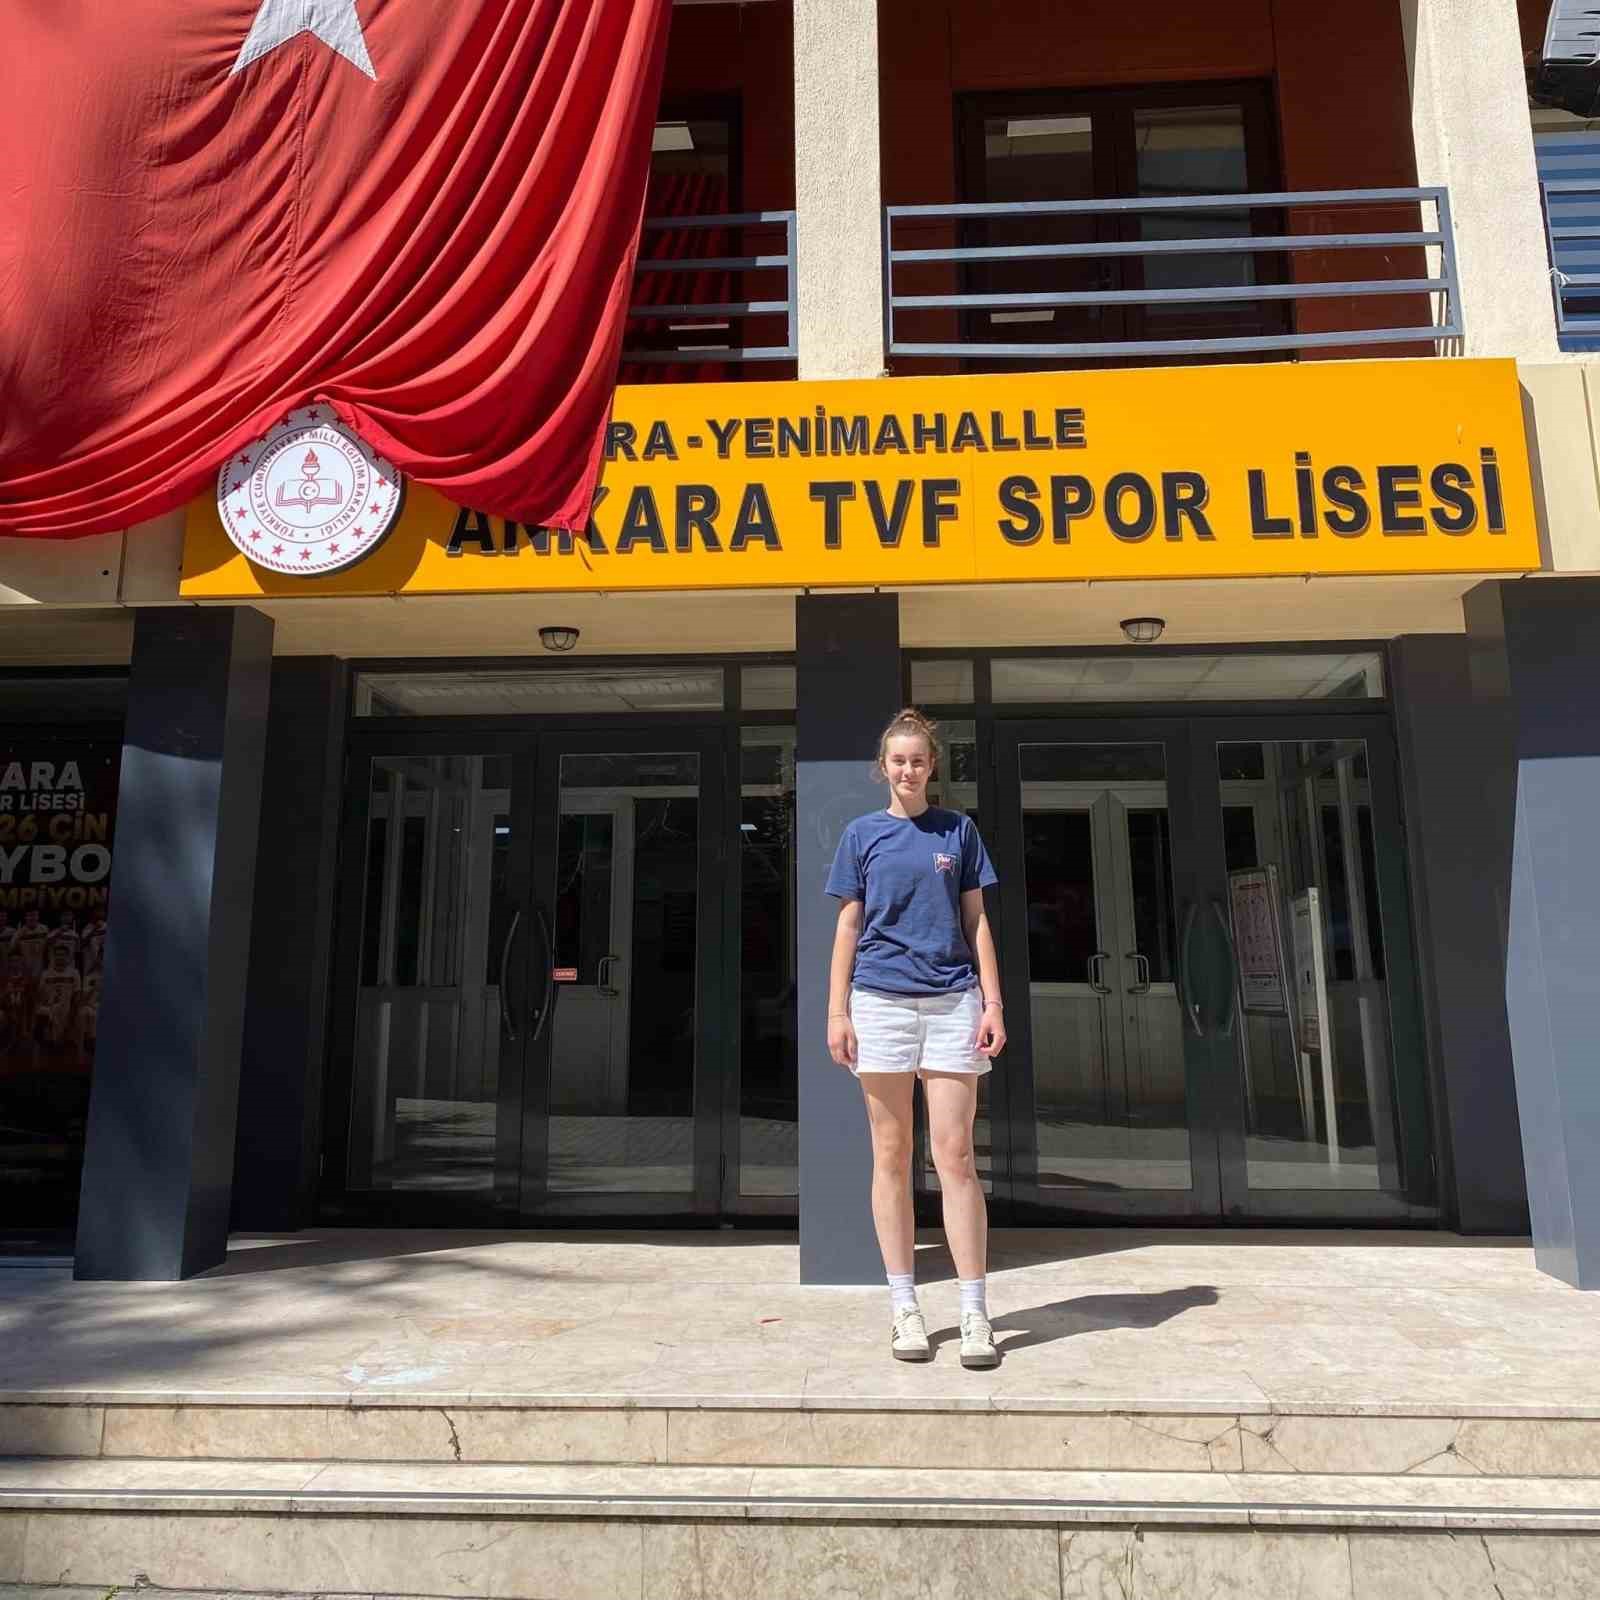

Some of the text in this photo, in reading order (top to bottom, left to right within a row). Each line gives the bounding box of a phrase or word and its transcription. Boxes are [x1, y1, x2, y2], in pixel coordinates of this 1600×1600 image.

[808, 477, 961, 549] TVF
[997, 471, 1216, 545] SPOR
[1247, 446, 1507, 540] LİSESİ
[0, 761, 83, 791] ARA
[20, 791, 86, 811] LİSESİ
[0, 843, 112, 883] YBO
